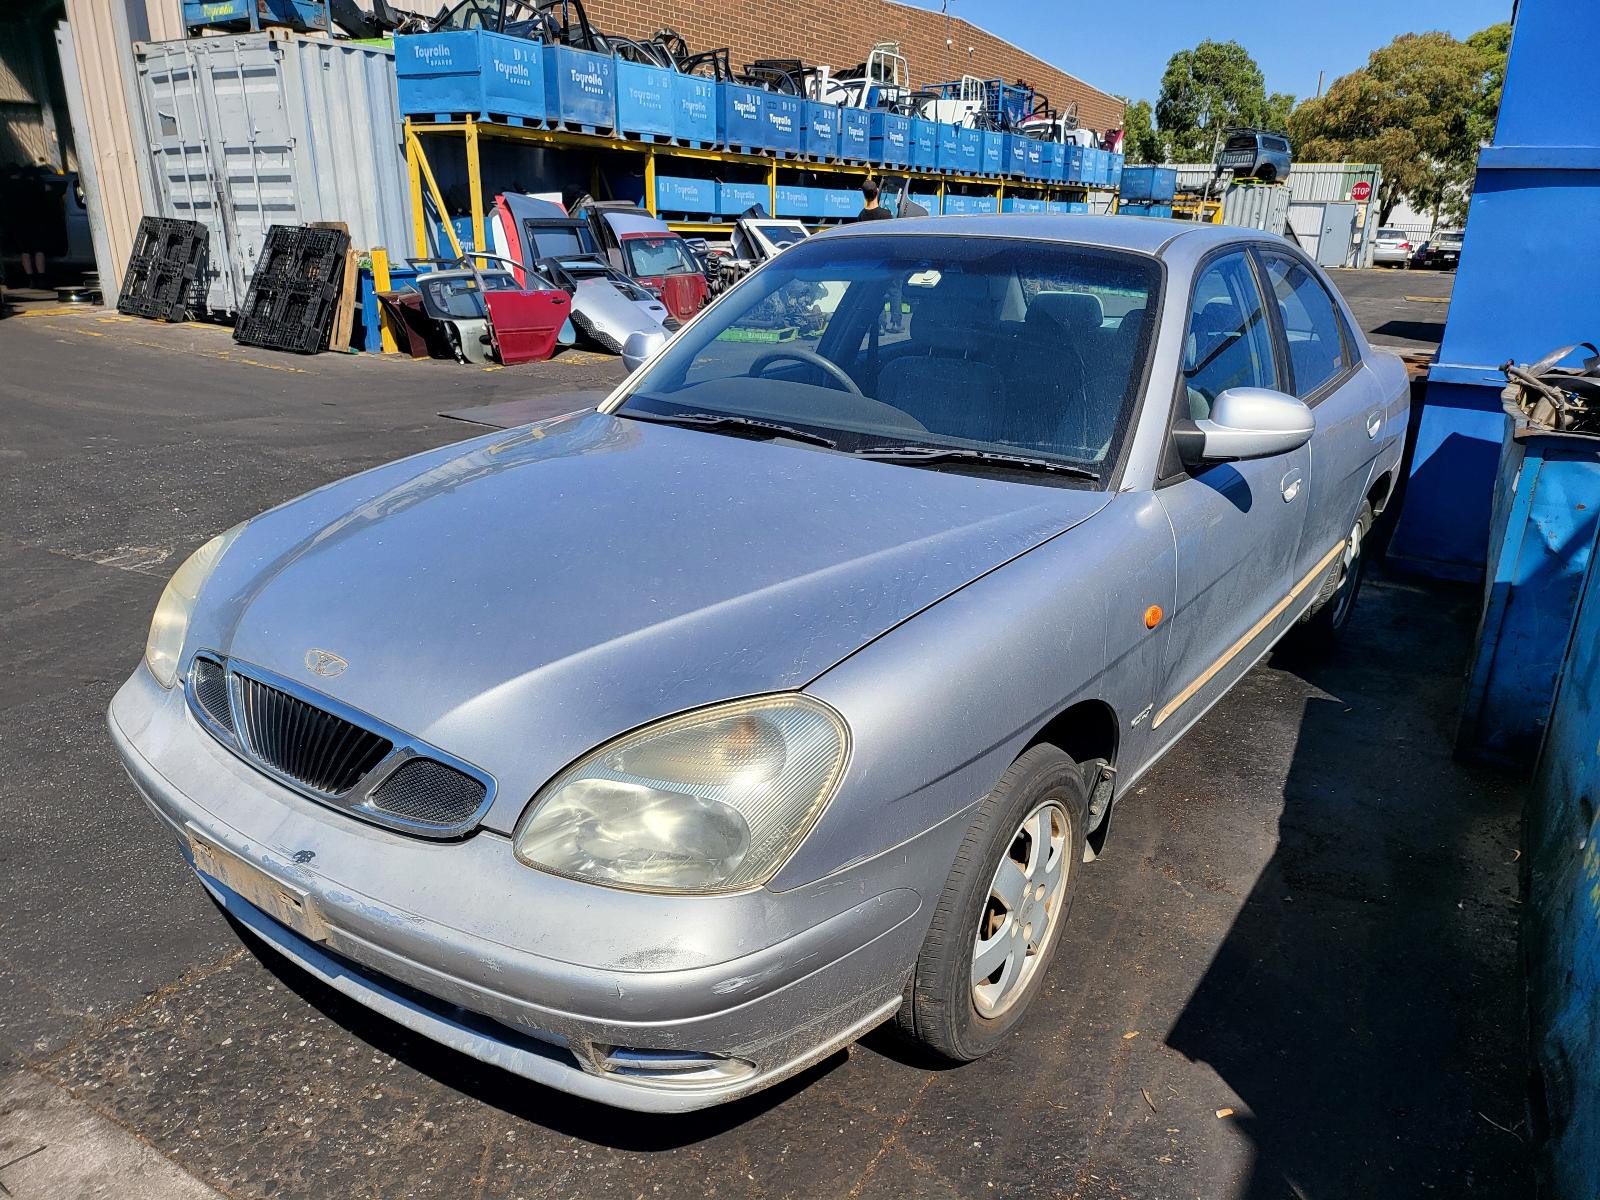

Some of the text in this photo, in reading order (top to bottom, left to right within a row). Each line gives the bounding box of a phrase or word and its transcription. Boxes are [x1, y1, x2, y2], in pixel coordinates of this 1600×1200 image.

[414, 45, 450, 63] Toyrolla
[494, 60, 529, 79] Toyrolla
[571, 69, 603, 89] Toyrolla
[585, 86, 604, 95] SPARES
[629, 87, 660, 104] Toyrolla
[682, 98, 706, 115] Toyrolla
[734, 100, 756, 116] Toyrolla
[769, 113, 791, 129] Toyrolla
[813, 121, 831, 135] Toyrolla
[848, 126, 864, 139] Toyrolla
[674, 184, 698, 200] Toyrolla
[734, 189, 755, 204] Toyrolla
[786, 192, 808, 206] Toyrolla
[1352, 187, 1371, 196] STOP
